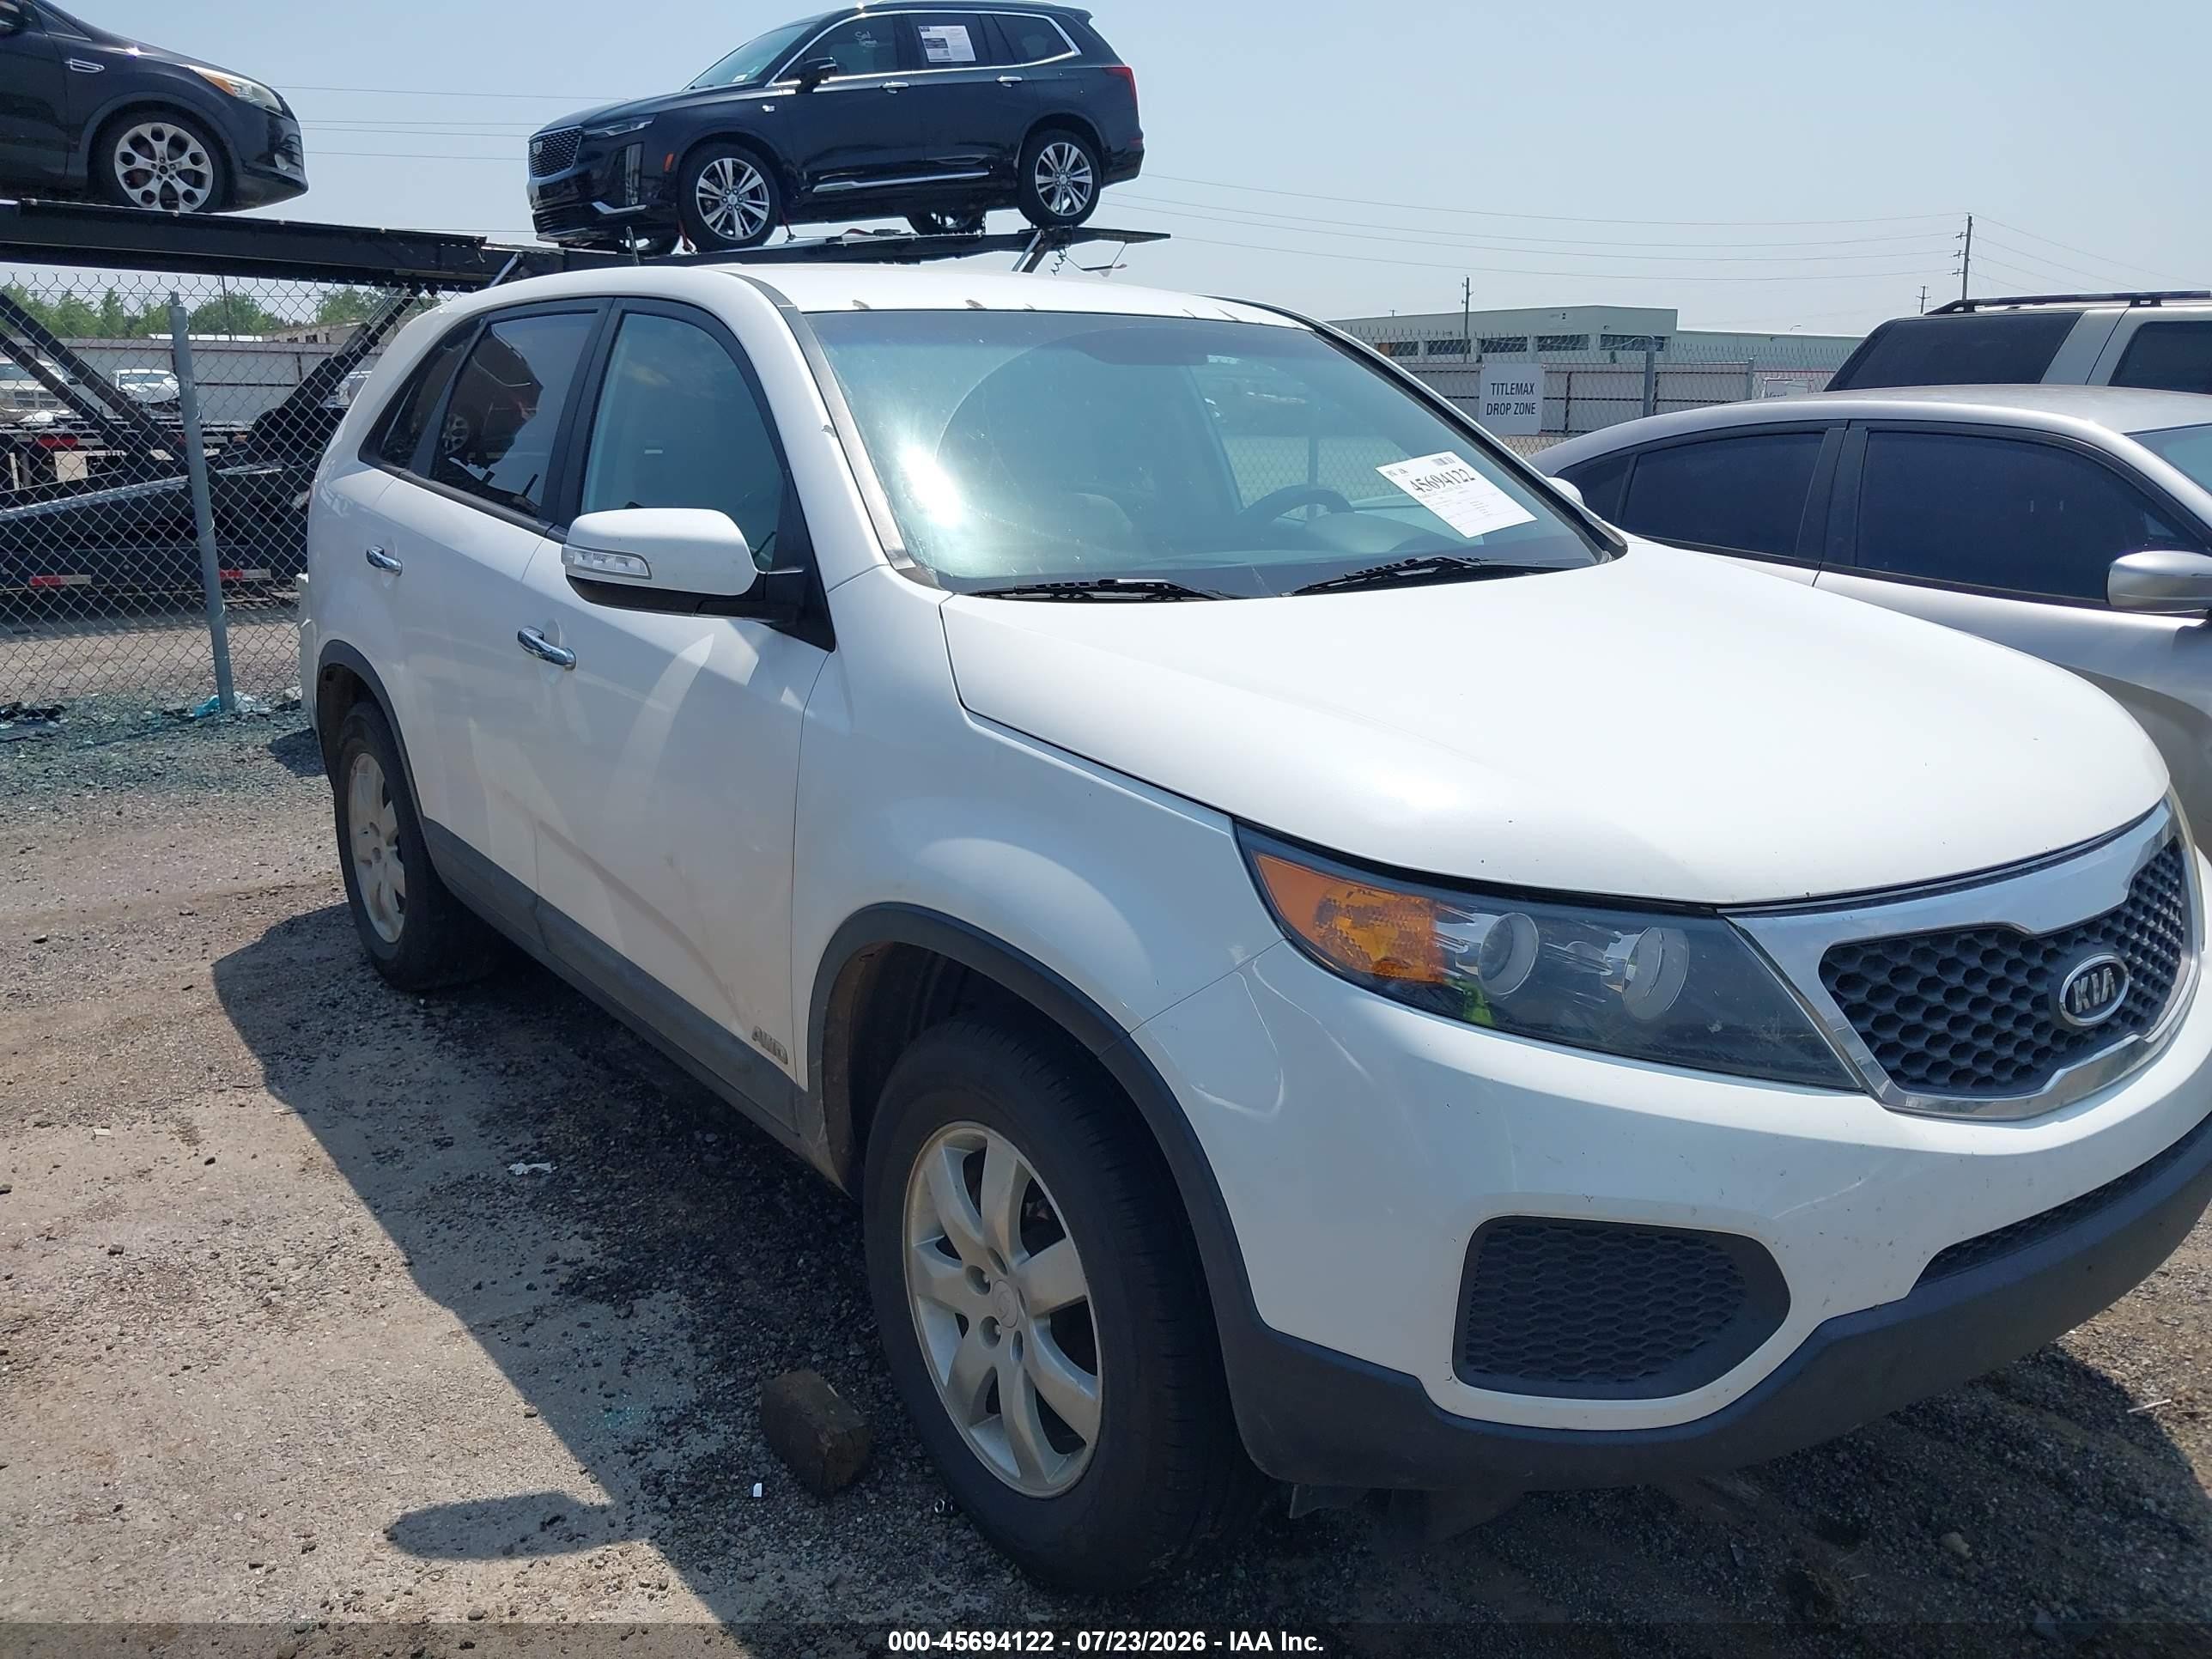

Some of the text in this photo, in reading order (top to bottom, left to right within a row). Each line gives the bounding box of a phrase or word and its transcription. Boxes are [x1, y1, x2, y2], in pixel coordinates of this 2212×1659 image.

[1490, 382, 1535, 396] TITLEMAX
[1486, 402, 1536, 416] DROP ZONE
[1409, 468, 1476, 494] 45694122
[2073, 967, 2117, 1014] KIA
